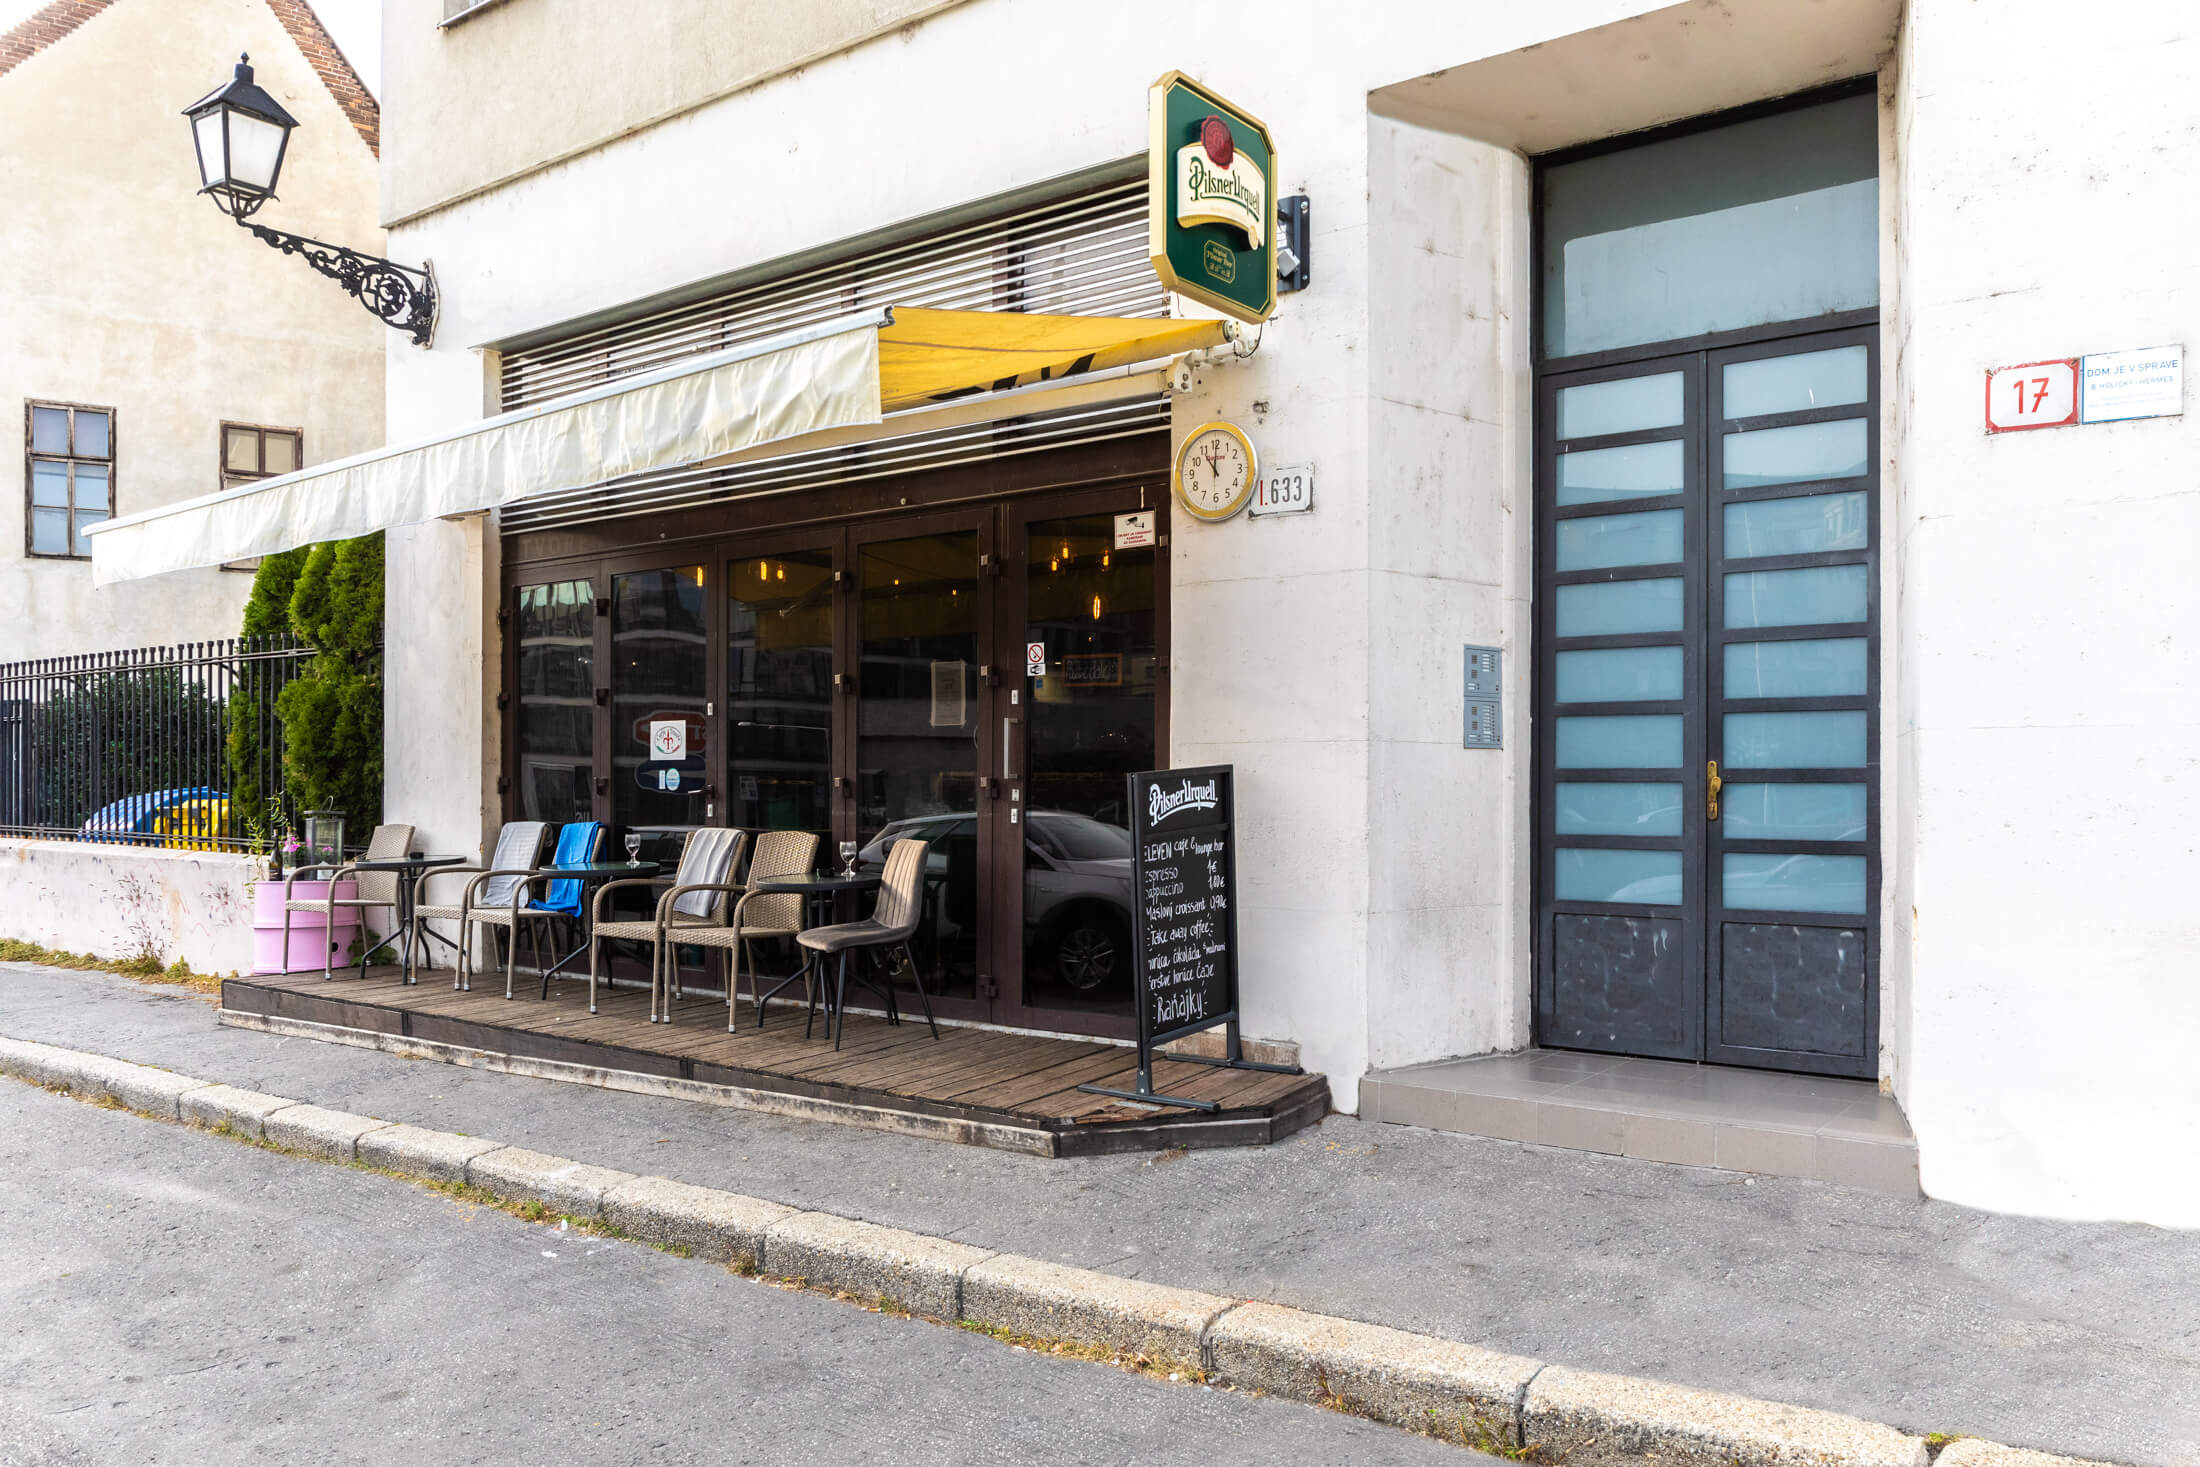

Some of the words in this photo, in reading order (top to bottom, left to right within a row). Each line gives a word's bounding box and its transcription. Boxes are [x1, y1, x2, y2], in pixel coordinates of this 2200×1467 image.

[1189, 156, 1233, 201] Pilsner
[1232, 170, 1260, 216] Urquell
[2087, 367, 2110, 377] DOM
[2113, 365, 2126, 375] JE
[2128, 364, 2136, 373] V
[2013, 377, 2049, 414] 17
[1200, 445, 1208, 456] 11
[1211, 440, 1220, 450] 12
[1225, 442, 1229, 452] 1
[1232, 449, 1238, 460] 2
[1192, 457, 1201, 467] 10
[1237, 463, 1243, 474] 3
[1189, 470, 1195, 479] 9
[1192, 481, 1199, 491] 8
[1232, 477, 1238, 487] 4
[1225, 488, 1230, 498] 5
[1271, 475, 1301, 504] 633
[1201, 491, 1206, 501] 7
[1213, 493, 1219, 503] 6
[1149, 784, 1185, 827] Pilsner
[1144, 842, 1172, 862] ELEVEN
[1175, 898, 1206, 914] croissant
[1169, 926, 1187, 942] away
[1189, 919, 1210, 940] coffee
